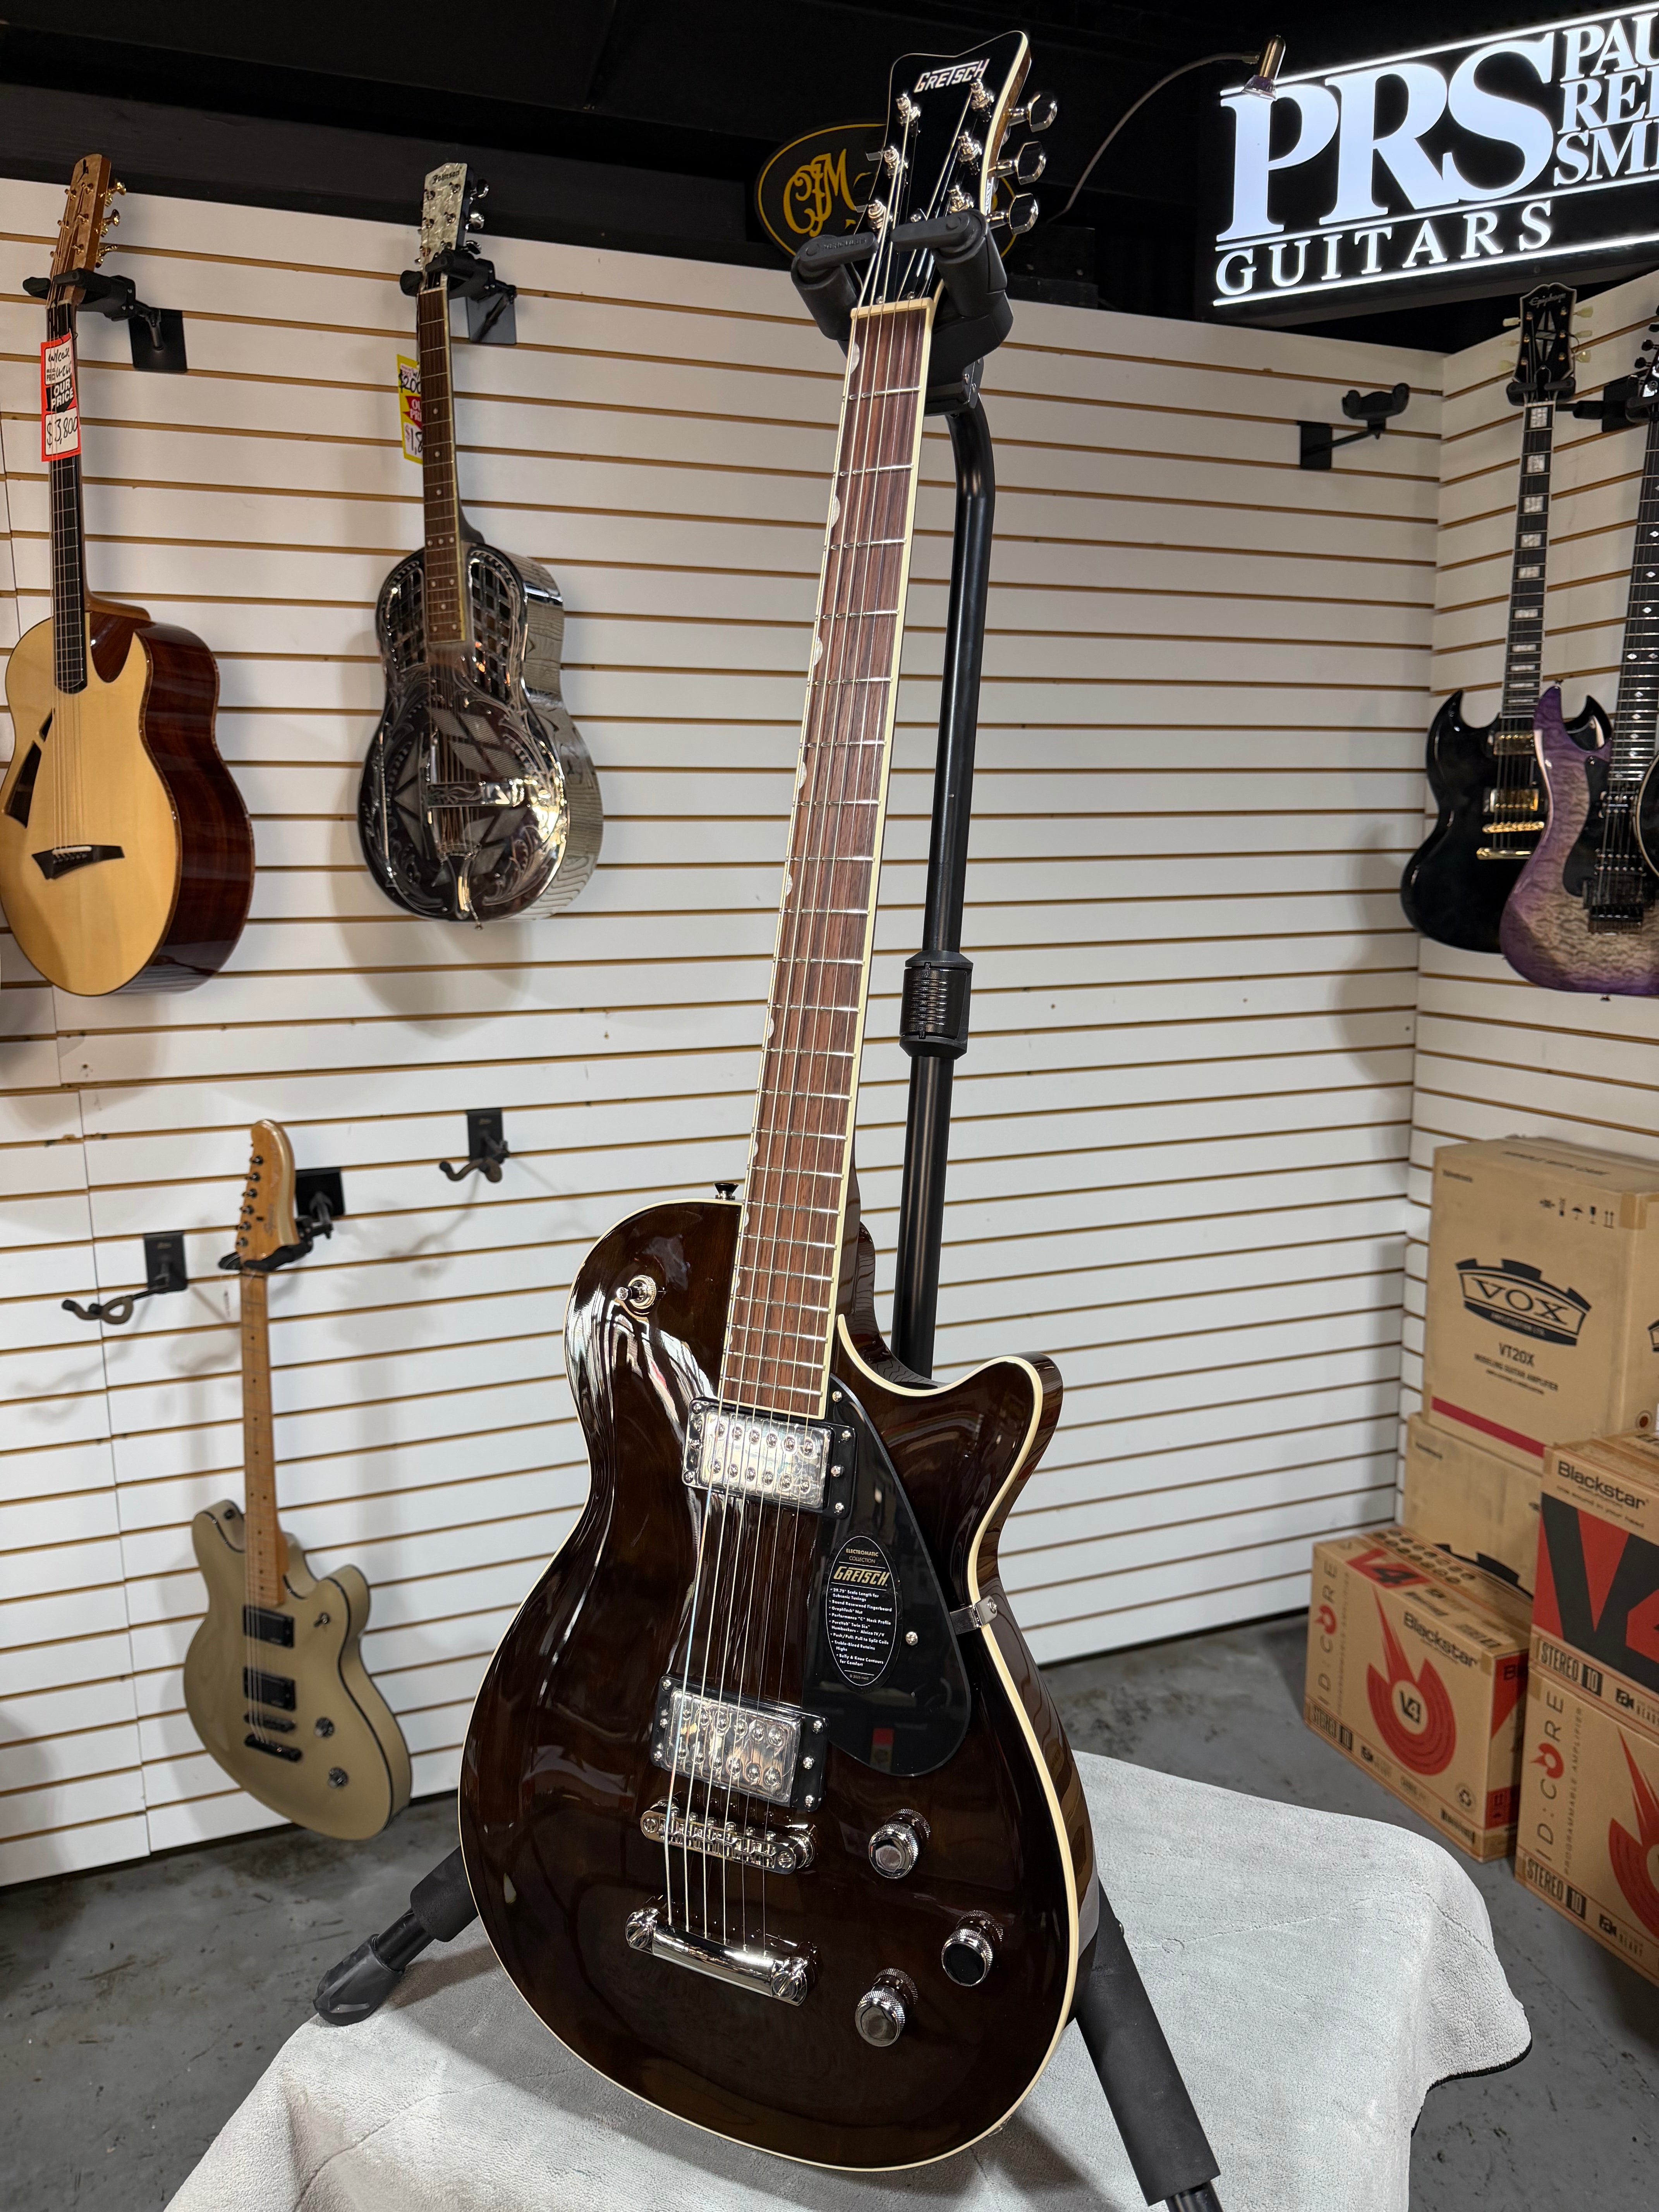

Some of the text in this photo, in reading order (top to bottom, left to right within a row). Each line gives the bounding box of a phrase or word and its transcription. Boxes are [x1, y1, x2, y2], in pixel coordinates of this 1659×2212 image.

[914, 58, 990, 93] GRETSCH
[1557, 65, 1659, 135] RE
[1216, 32, 1554, 242] PRS
[432, 170, 460, 184] Johnson
[1215, 201, 1551, 296] GUITARS
[51, 387, 74, 410] PRICE
[53, 378, 70, 397] OUR
[47, 416, 77, 448] $3,800
[1472, 1277, 1569, 1325] VOX
[1498, 1341, 1535, 1368] VT20X
[1558, 1460, 1645, 1510] Blackstar
[846, 1548, 879, 1557] ELECTROMATIC
[833, 1566, 890, 1586] GRETSCH
[1403, 1611, 1478, 1668] Blackstar
[1541, 1642, 1579, 1682] STEREO
[1571, 1706, 1583, 1773] AMPLIFIER
[1527, 1858, 1564, 1902] STEREO
